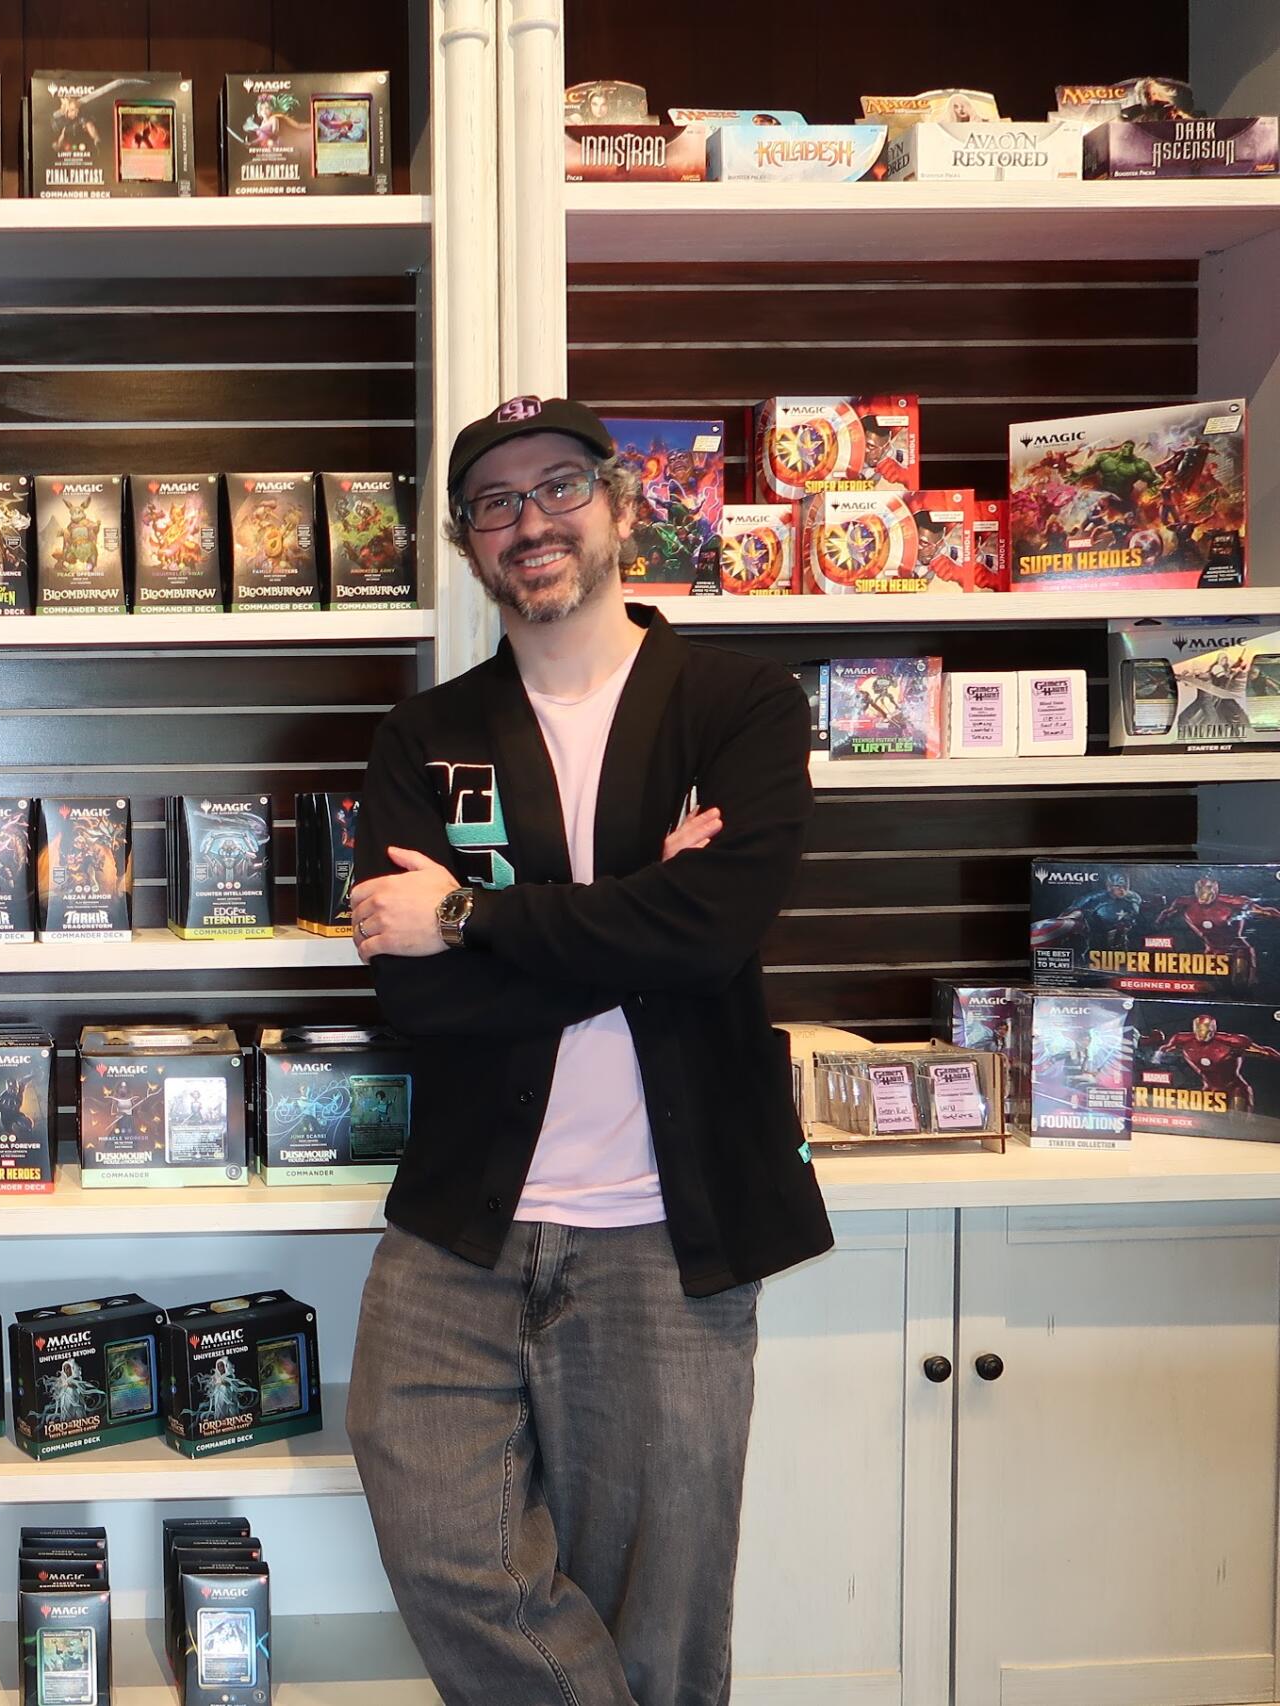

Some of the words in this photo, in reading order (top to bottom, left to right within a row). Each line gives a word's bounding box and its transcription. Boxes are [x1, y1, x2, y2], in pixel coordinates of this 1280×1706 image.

[1175, 122, 1216, 139] DARK
[963, 132, 1038, 150] AVACYN
[581, 133, 667, 171] INNISTRAD
[754, 140, 855, 168] KALADESH
[951, 150, 1049, 167] RESTORED
[1152, 141, 1235, 167] ASCENSION
[45, 169, 70, 184] FINAL
[70, 169, 105, 185] FANTASY
[241, 164, 265, 180] FINAL
[265, 164, 300, 180] FANTASY
[235, 186, 282, 195] COMMANDER
[284, 185, 306, 194] DECK
[1033, 431, 1087, 446] MAGIC
[63, 483, 104, 493] MAGIC
[159, 481, 200, 492] MAGIC
[255, 481, 295, 491] MAGIC
[351, 481, 391, 490] MAGIC
[1019, 555, 1074, 575] SUPER
[1077, 548, 1143, 569] HEROES
[238, 585, 314, 598] BLOOMBURROW
[336, 585, 410, 598] BLOOMBURROW
[855, 578, 888, 593] SUPER
[889, 578, 928, 592] HEROES
[42, 588, 120, 601] BLOOMBURROW
[140, 588, 216, 601] BLOOMBURROW
[42, 606, 97, 614] COMMANDER
[195, 605, 217, 613] DECK
[238, 603, 291, 611] COMMANDER
[293, 602, 314, 610] DECK
[337, 602, 389, 610] COMMANDER
[1034, 680, 1068, 691] Gamers
[1041, 686, 1068, 696] Haunt
[1177, 726, 1204, 738] FINAL
[1206, 724, 1246, 738] FANTASY
[852, 742, 914, 753] TURTLES
[1047, 872, 1099, 882] MAGIC
[213, 906, 239, 916] EDGE
[202, 915, 257, 924] ETERNITIES
[1144, 938, 1172, 948] MARVEL
[1088, 951, 1151, 971] SUPER
[1154, 952, 1229, 975] HEROES
[1120, 980, 1171, 989] BEGINNER
[1174, 982, 1195, 991] BOX
[1142, 1073, 1170, 1083] MARVEL
[1153, 1087, 1227, 1112] HEROES
[1040, 1115, 1125, 1133] FOUNDATIONS
[1048, 1139, 1075, 1147] STARTER
[1076, 1140, 1116, 1149] COLLECTION
[95, 1152, 153, 1162] DUSKMOURN
[279, 1150, 337, 1161] DUSKMOURN
[7, 1167, 41, 1180] HEROES
[47, 1330, 92, 1347] MAGIC
[200, 1328, 244, 1345] MAGIC
[39, 1353, 71, 1363] UNIVERSES
[72, 1348, 96, 1358] BEYOND
[193, 1350, 225, 1361] UNIVERSES
[226, 1345, 249, 1355] BEYOND
